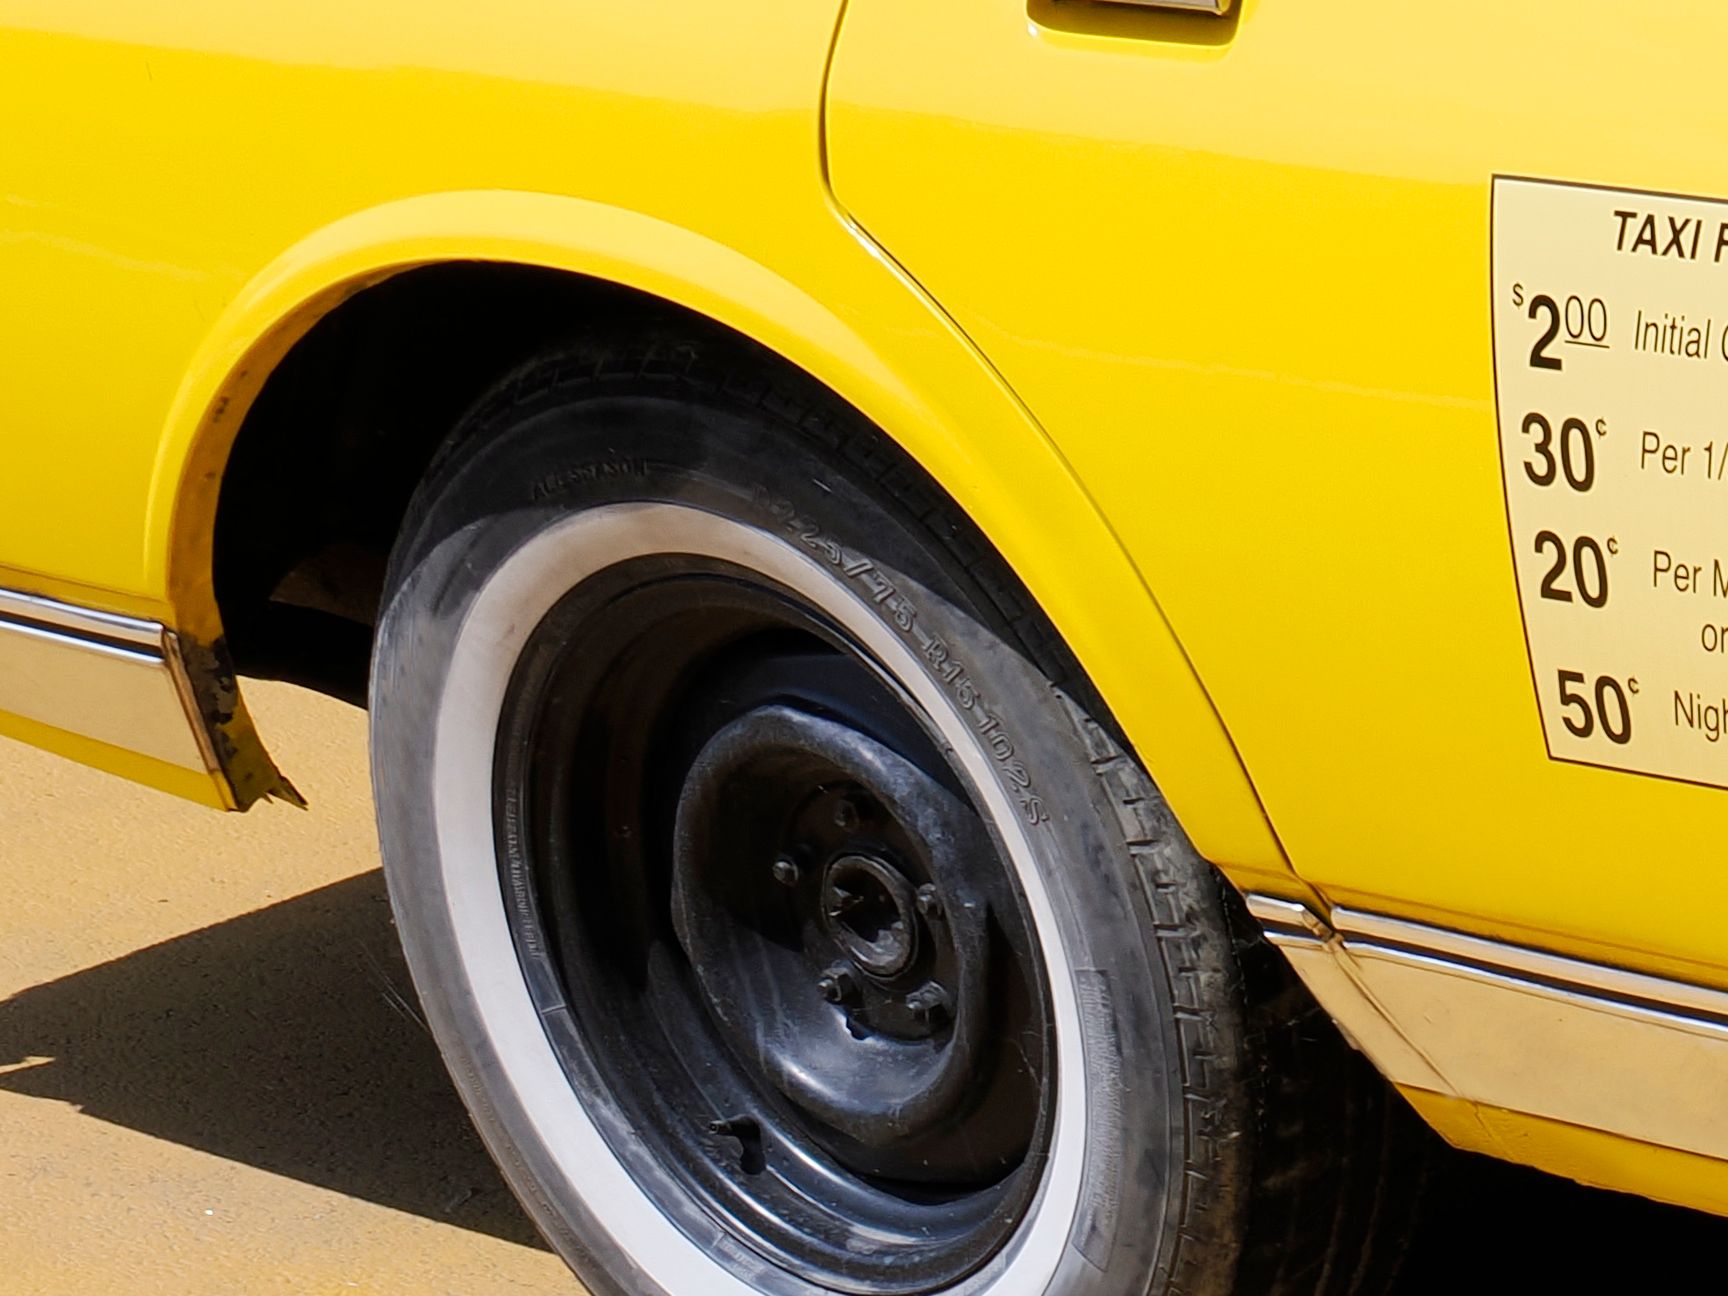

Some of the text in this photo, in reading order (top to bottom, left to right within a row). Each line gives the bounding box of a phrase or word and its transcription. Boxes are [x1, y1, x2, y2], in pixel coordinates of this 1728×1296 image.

[1613, 210, 1703, 260] TAXI
[1634, 310, 1711, 359] Initial
[1641, 430, 1691, 475] Per
[1653, 549, 1702, 594] Per
